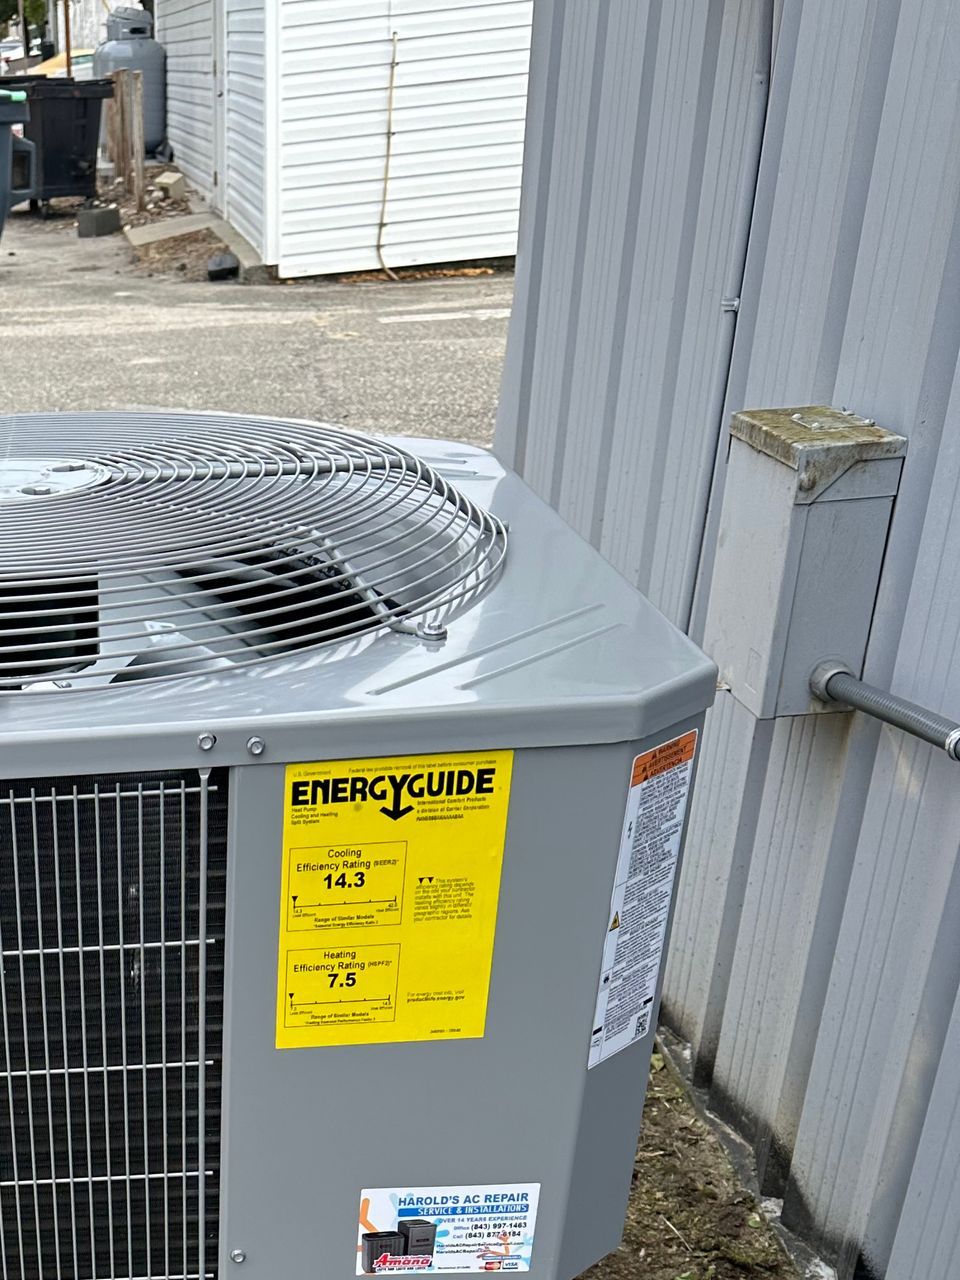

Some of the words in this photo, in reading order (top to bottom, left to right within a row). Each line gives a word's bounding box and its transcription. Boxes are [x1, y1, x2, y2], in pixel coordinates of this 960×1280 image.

[291, 768, 496, 817] ENERGYGUIDE
[327, 849, 362, 859] Cooling
[296, 862, 340, 872] Efficiency
[342, 860, 371, 870] Rating
[323, 871, 365, 889] 14.3
[323, 951, 356, 960] Heating
[293, 963, 335, 973] Efficiency
[337, 961, 366, 970] Rating
[327, 972, 356, 988] 7.5
[398, 1195, 460, 1206] HAROLD'S
[463, 1194, 481, 1204] AC
[484, 1192, 529, 1203] REPAIR
[418, 1206, 452, 1215] SERVICE
[456, 1206, 463, 1214] &
[465, 1204, 527, 1214] INSTALLATIONS
[471, 1223, 491, 1231] (843)
[465, 1231, 485, 1239] (843)
[374, 1253, 431, 1267] Amana
